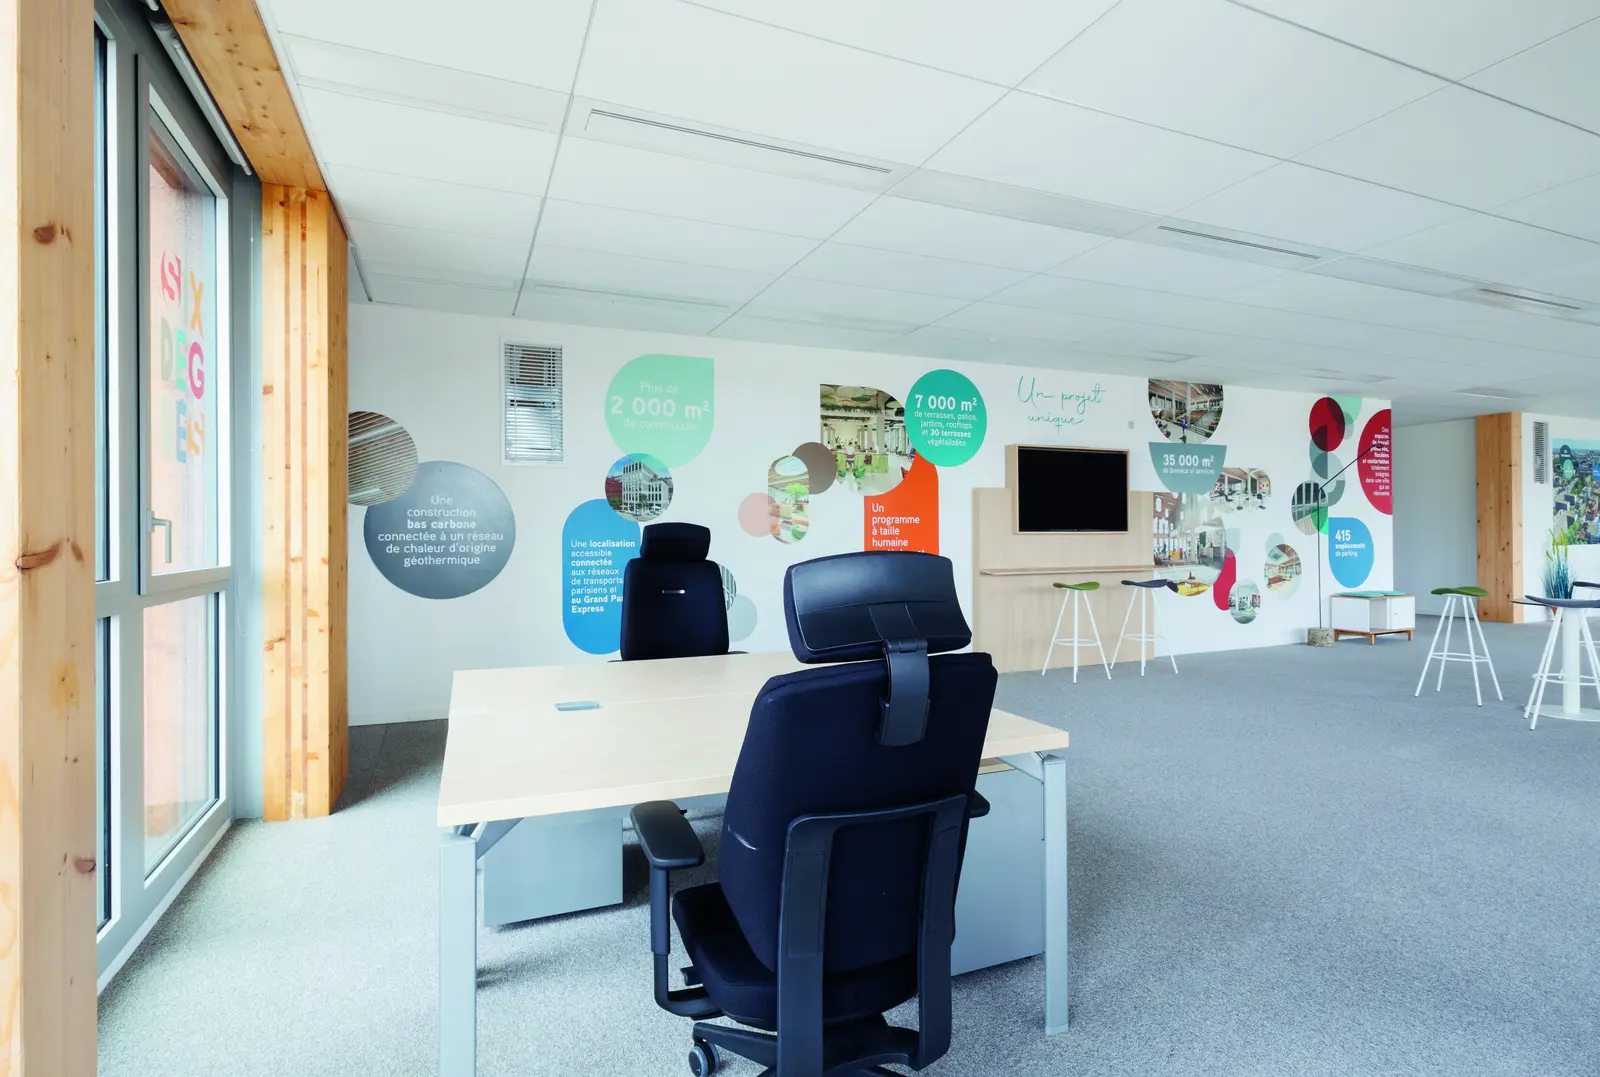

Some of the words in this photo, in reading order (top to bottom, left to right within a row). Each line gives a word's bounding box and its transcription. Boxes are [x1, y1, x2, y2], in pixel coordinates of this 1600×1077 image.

[640, 381, 663, 394] Plus
[666, 384, 678, 394] de
[1017, 375, 1054, 409] Un
[1061, 382, 1106, 415] projet
[611, 395, 624, 414] 2
[632, 396, 676, 417] 000
[684, 400, 710, 420] m²
[915, 394, 923, 408] 7
[928, 395, 956, 410] 000
[961, 397, 978, 411] m²
[924, 411, 956, 420] terrasses,
[957, 412, 978, 421] patios,
[624, 418, 636, 428] de
[920, 420, 945, 428] jardins,
[946, 421, 972, 430] rooftops
[1028, 412, 1084, 434] unique
[942, 430, 971, 438] terrasses
[1163, 454, 1176, 466] 35
[1179, 455, 1199, 466] 000
[431, 495, 453, 506] Une
[407, 508, 476, 517] construction
[872, 503, 884, 512] Un
[407, 520, 427, 529] bas
[431, 520, 476, 529] carbone
[872, 516, 920, 526] programme
[872, 526, 877, 535] à
[880, 526, 900, 535] taille
[1335, 530, 1351, 541] 415
[378, 532, 436, 541] connectée
[440, 532, 446, 541] à
[468, 531, 504, 541] réseau
[571, 540, 587, 548] Une
[872, 537, 908, 546] humaine
[386, 544, 400, 553] de
[404, 544, 444, 553] chaleur
[449, 542, 496, 555] d'origine
[571, 549, 612, 557] accessible
[404, 555, 480, 568] géothermique
[571, 559, 612, 567] connectée
[588, 568, 619, 576] réseaux
[584, 577, 624, 586] transports
[571, 587, 607, 596] parisiens
[584, 595, 608, 603] Grand
[571, 606, 604, 615] Express
